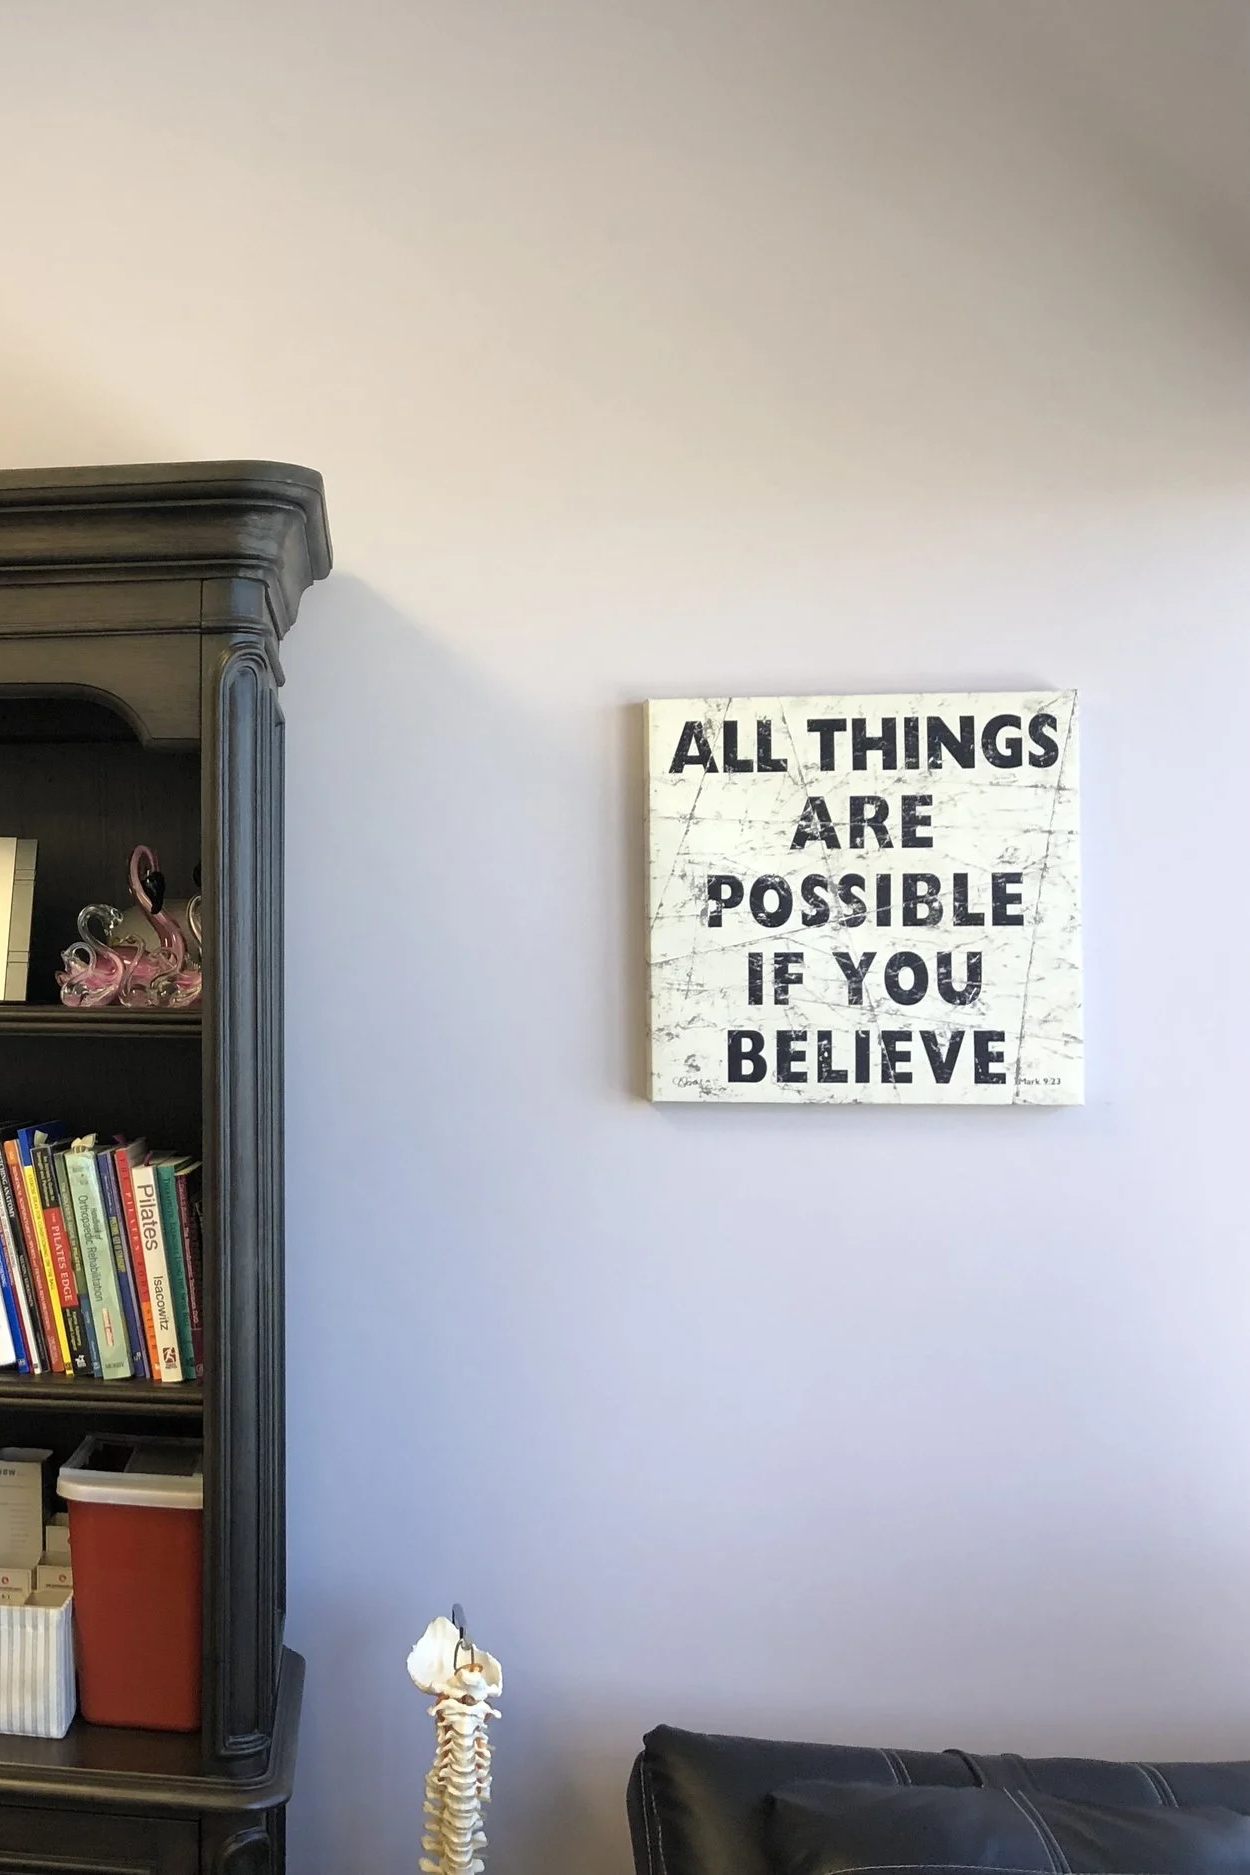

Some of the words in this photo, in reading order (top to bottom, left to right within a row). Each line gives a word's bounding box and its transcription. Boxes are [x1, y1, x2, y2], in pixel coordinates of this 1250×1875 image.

[668, 719, 788, 774] ALL
[807, 714, 1060, 772] THINGS
[790, 794, 934, 850] ARE
[707, 871, 1025, 928] POSSIBLE
[747, 951, 804, 1006] IF
[833, 951, 983, 1006] YOU
[726, 1029, 1007, 1085] BELIEVE
[3, 1185, 15, 1218] ANATOMY
[126, 1191, 140, 1251] PILATES
[137, 1183, 158, 1251] Pilates
[52, 1225, 67, 1269] PILATES
[61, 1272, 73, 1301] EDGE
[72, 1246, 81, 1271] PILATES
[78, 1194, 94, 1245] Orthopaedic
[87, 1246, 103, 1302] Rehabilitation
[154, 1275, 169, 1331] Isacowitz
